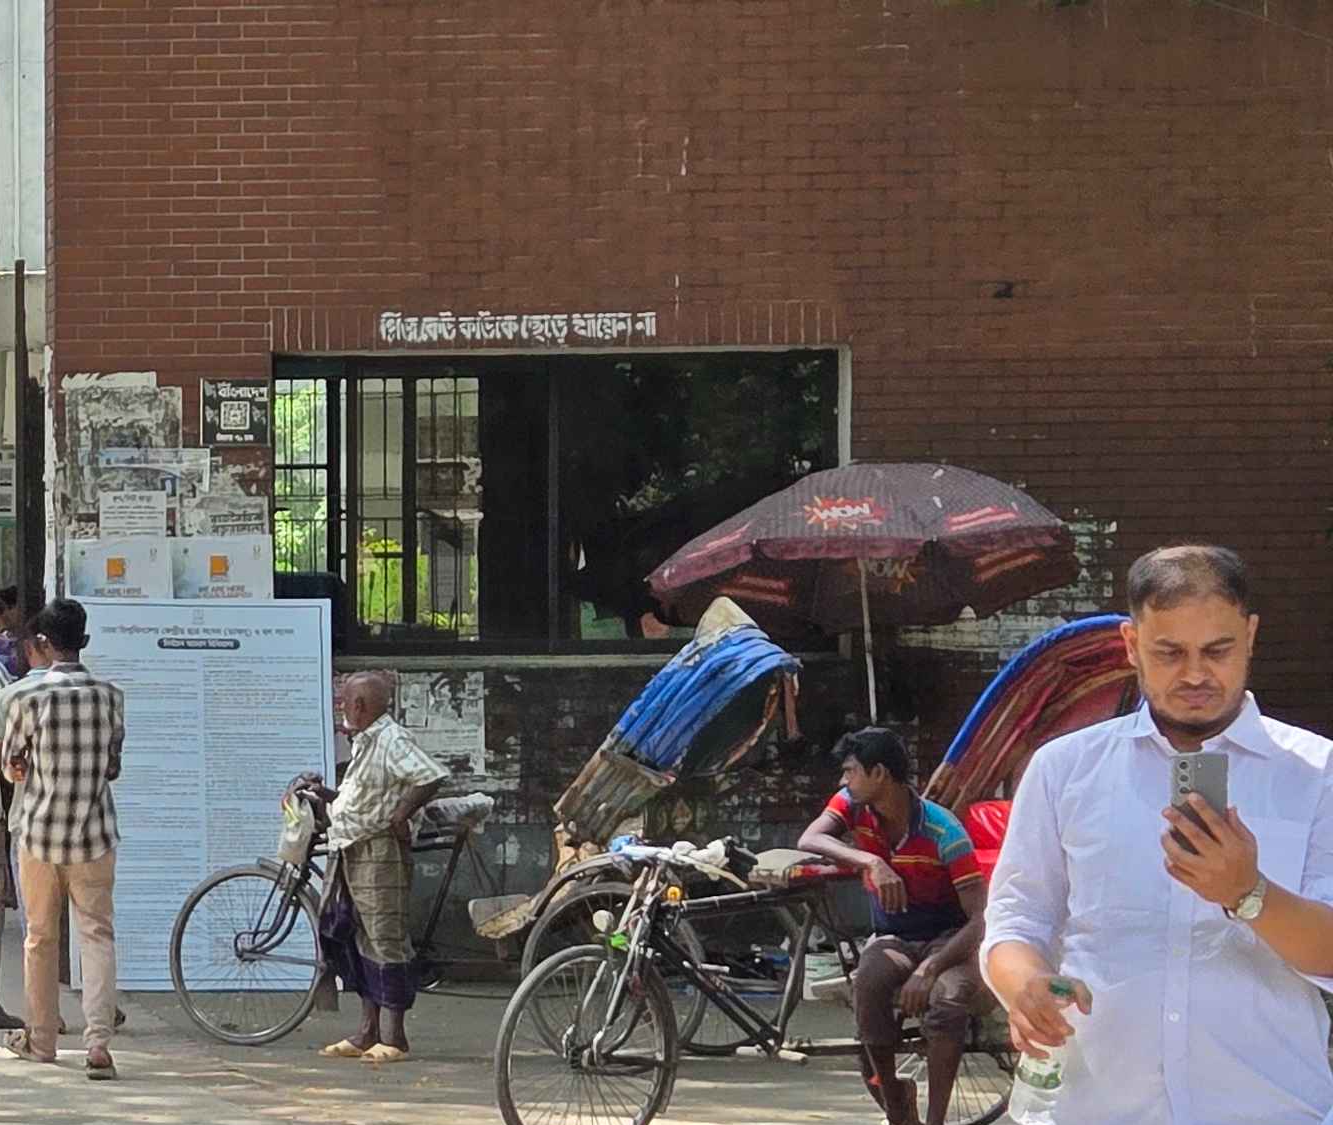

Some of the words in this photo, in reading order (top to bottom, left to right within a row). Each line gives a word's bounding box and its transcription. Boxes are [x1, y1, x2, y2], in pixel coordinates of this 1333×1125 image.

[420, 312, 456, 341] কেউ
[459, 311, 518, 340] কাউকে
[635, 311, 657, 337] না
